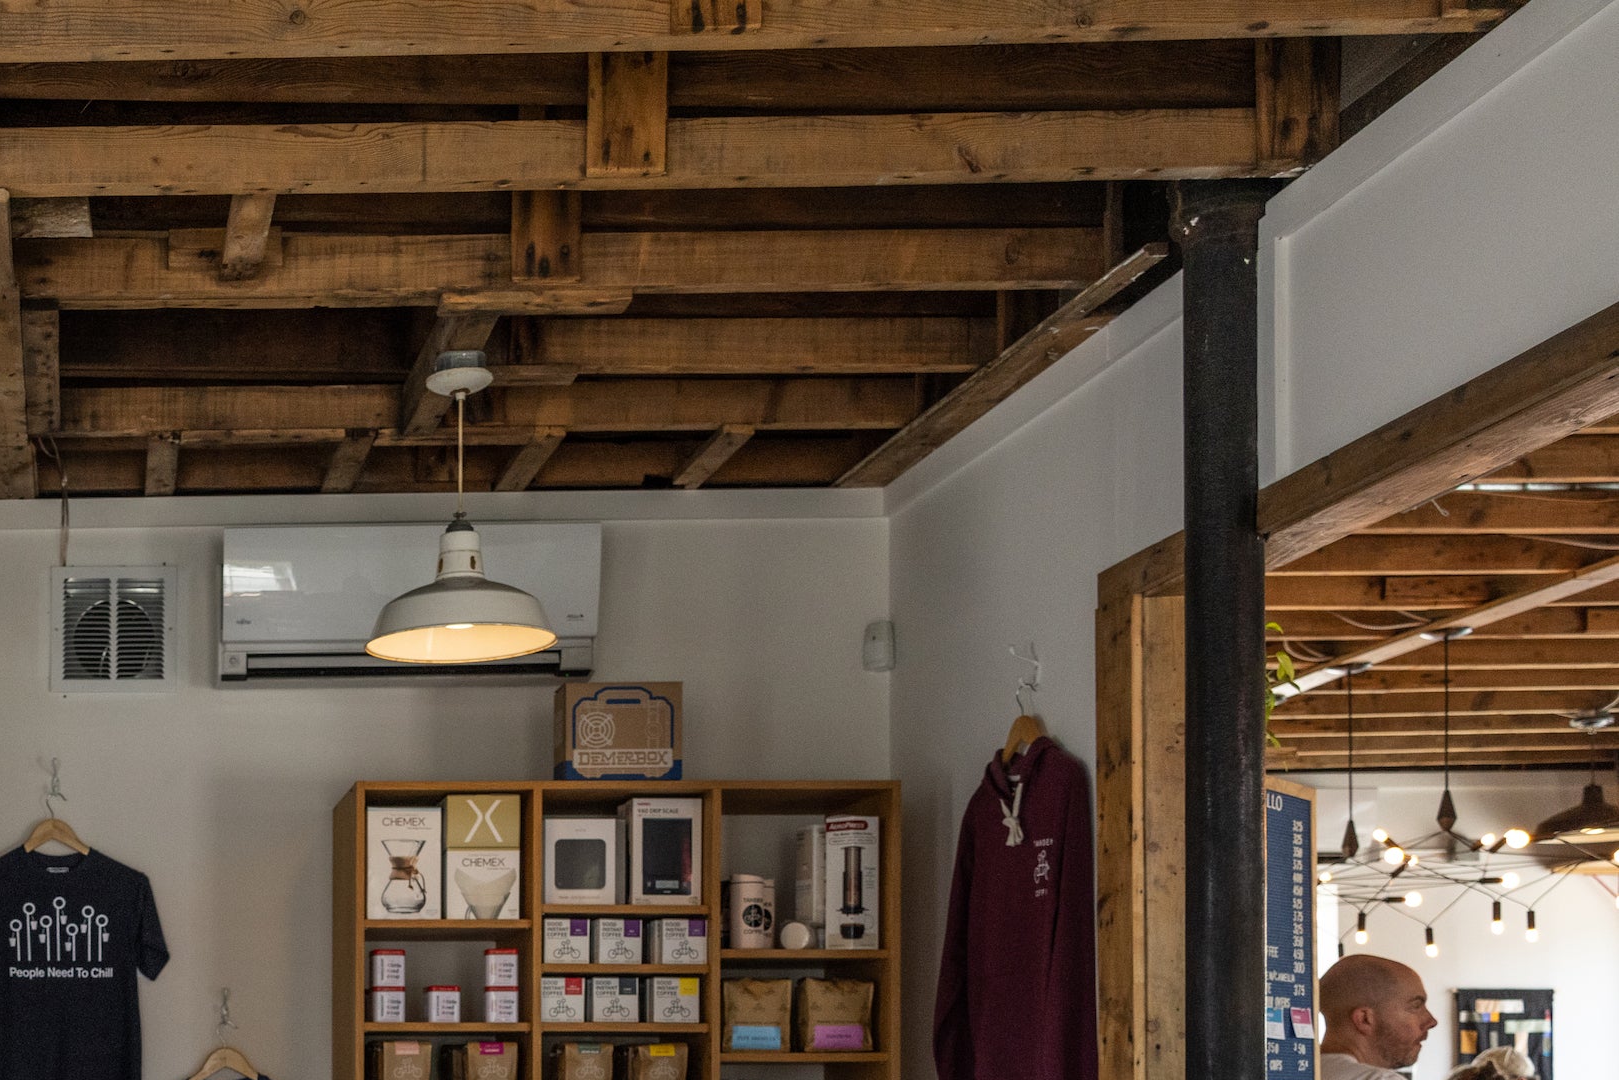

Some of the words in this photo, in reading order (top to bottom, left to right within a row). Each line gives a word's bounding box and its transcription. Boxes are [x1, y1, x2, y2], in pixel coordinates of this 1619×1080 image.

[578, 751, 668, 766] DEMERBOX
[382, 817, 426, 827] CHEMEX
[461, 858, 506, 867] CHEMEX
[9, 967, 45, 980] People
[47, 967, 74, 978] Need
[75, 967, 89, 978] To
[90, 967, 114, 978] Chill
